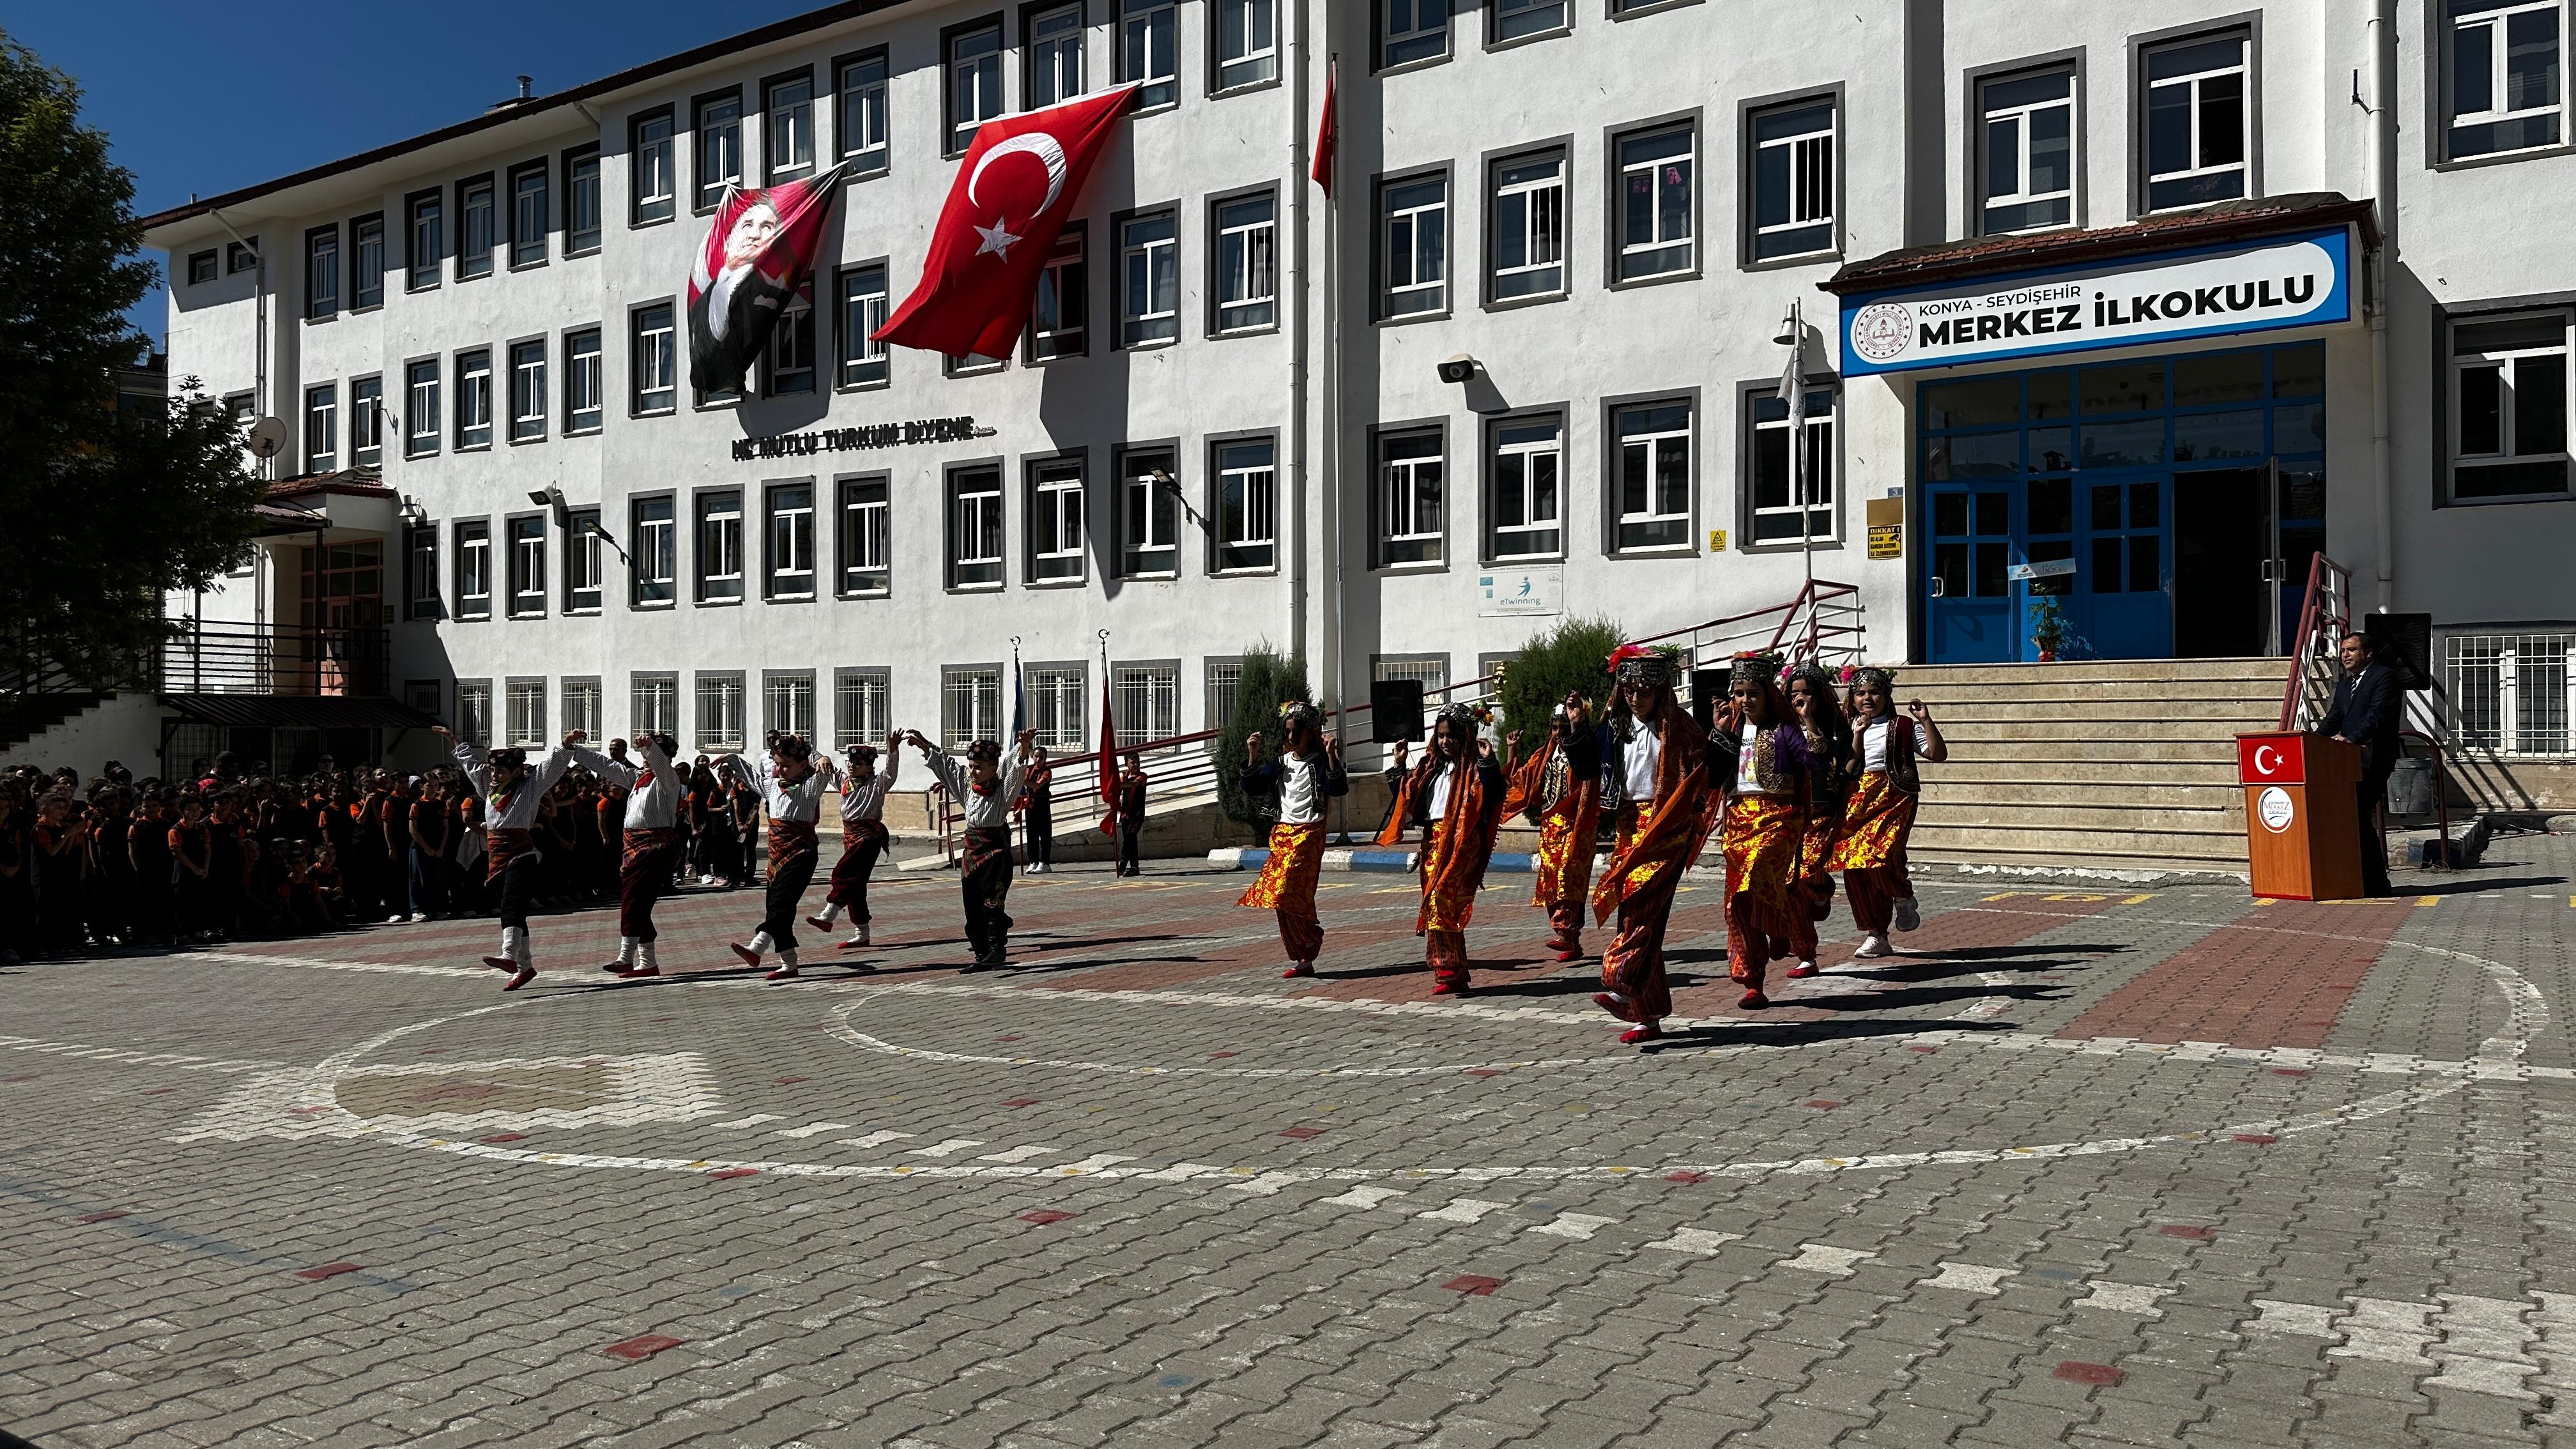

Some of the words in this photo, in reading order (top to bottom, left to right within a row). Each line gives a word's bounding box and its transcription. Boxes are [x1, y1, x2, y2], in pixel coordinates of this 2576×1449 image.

[1919, 300, 1973, 317] KONYA
[1986, 284, 2081, 308] SEYDİŞEHİR
[1919, 303, 2082, 348] MERKEZ
[2094, 274, 2315, 328] İLKOKULU
[759, 431, 818, 459] MUTLU
[822, 422, 900, 452] TÜRKÜM
[905, 415, 974, 445] DİYENE
